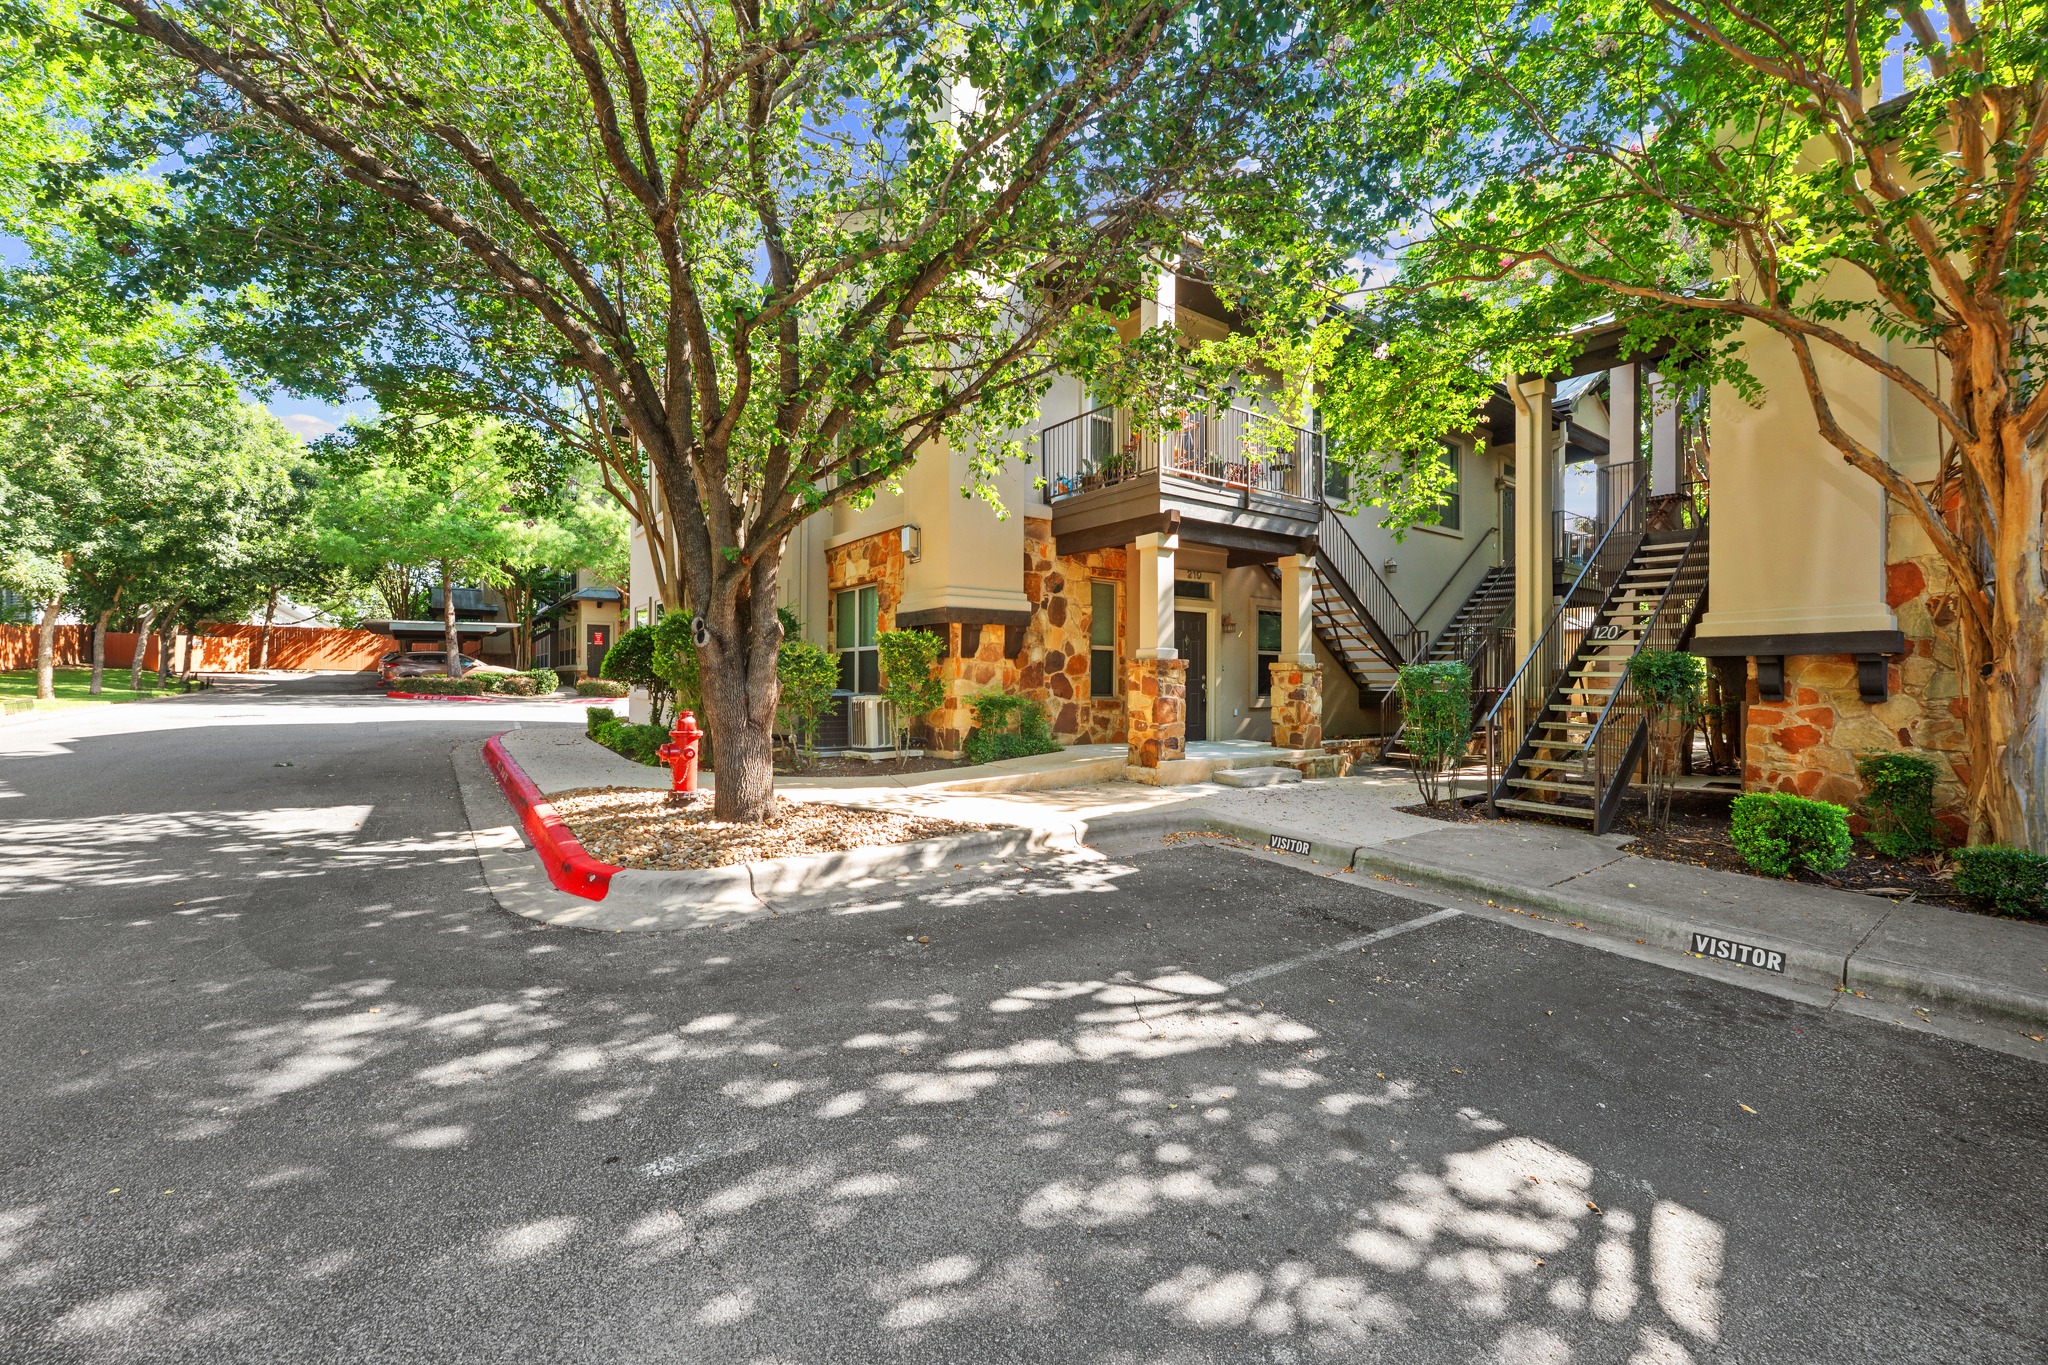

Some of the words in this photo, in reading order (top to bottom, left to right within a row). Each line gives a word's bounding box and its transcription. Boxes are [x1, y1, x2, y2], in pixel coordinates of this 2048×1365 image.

[1187, 570, 1202, 579] 210
[1593, 625, 1619, 639] 120
[1271, 835, 1310, 855] VISITOR
[1695, 934, 1782, 971] VISITOR
